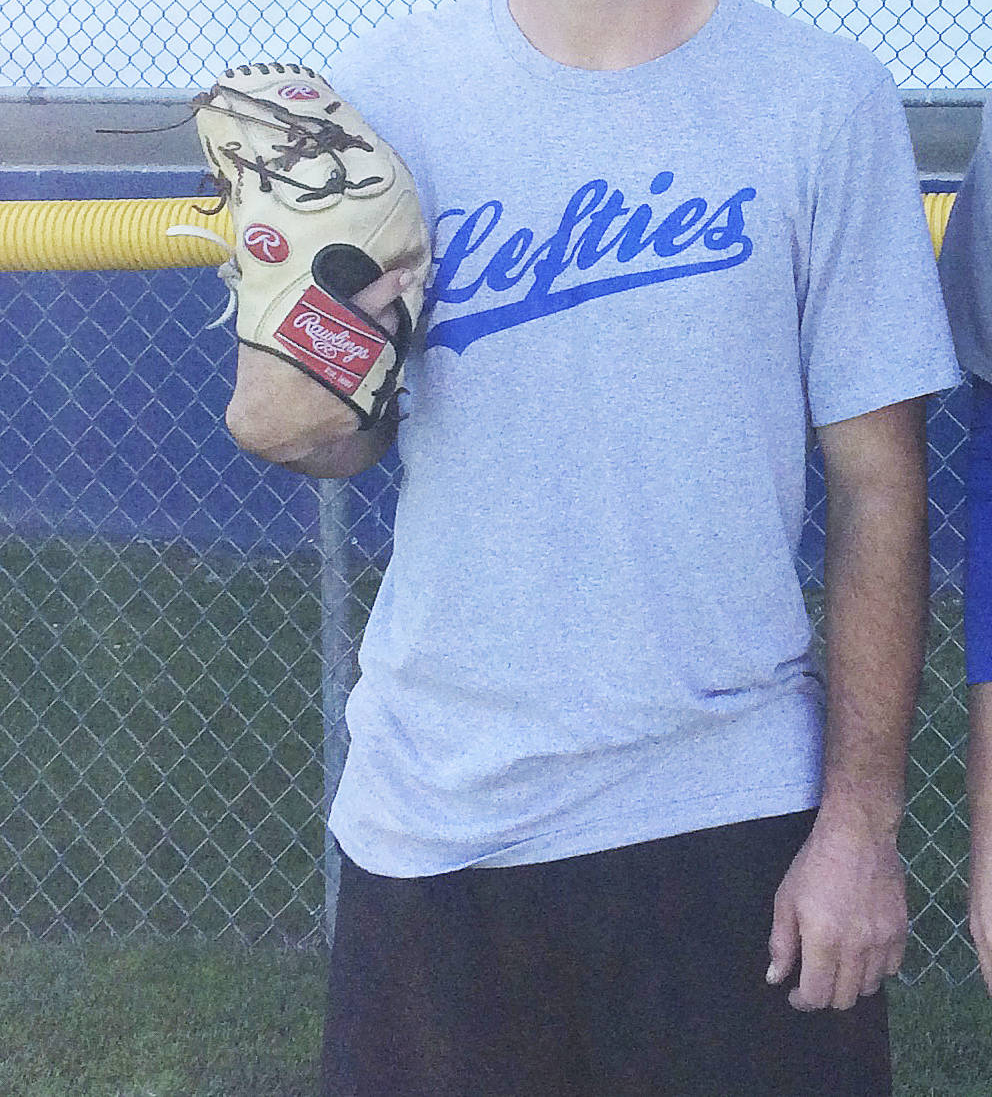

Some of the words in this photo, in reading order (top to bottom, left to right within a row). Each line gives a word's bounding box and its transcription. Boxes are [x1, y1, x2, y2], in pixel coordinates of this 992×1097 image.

[244, 225, 282, 262] R
[430, 170, 757, 310] Lefties
[293, 311, 370, 363] Rawlings
